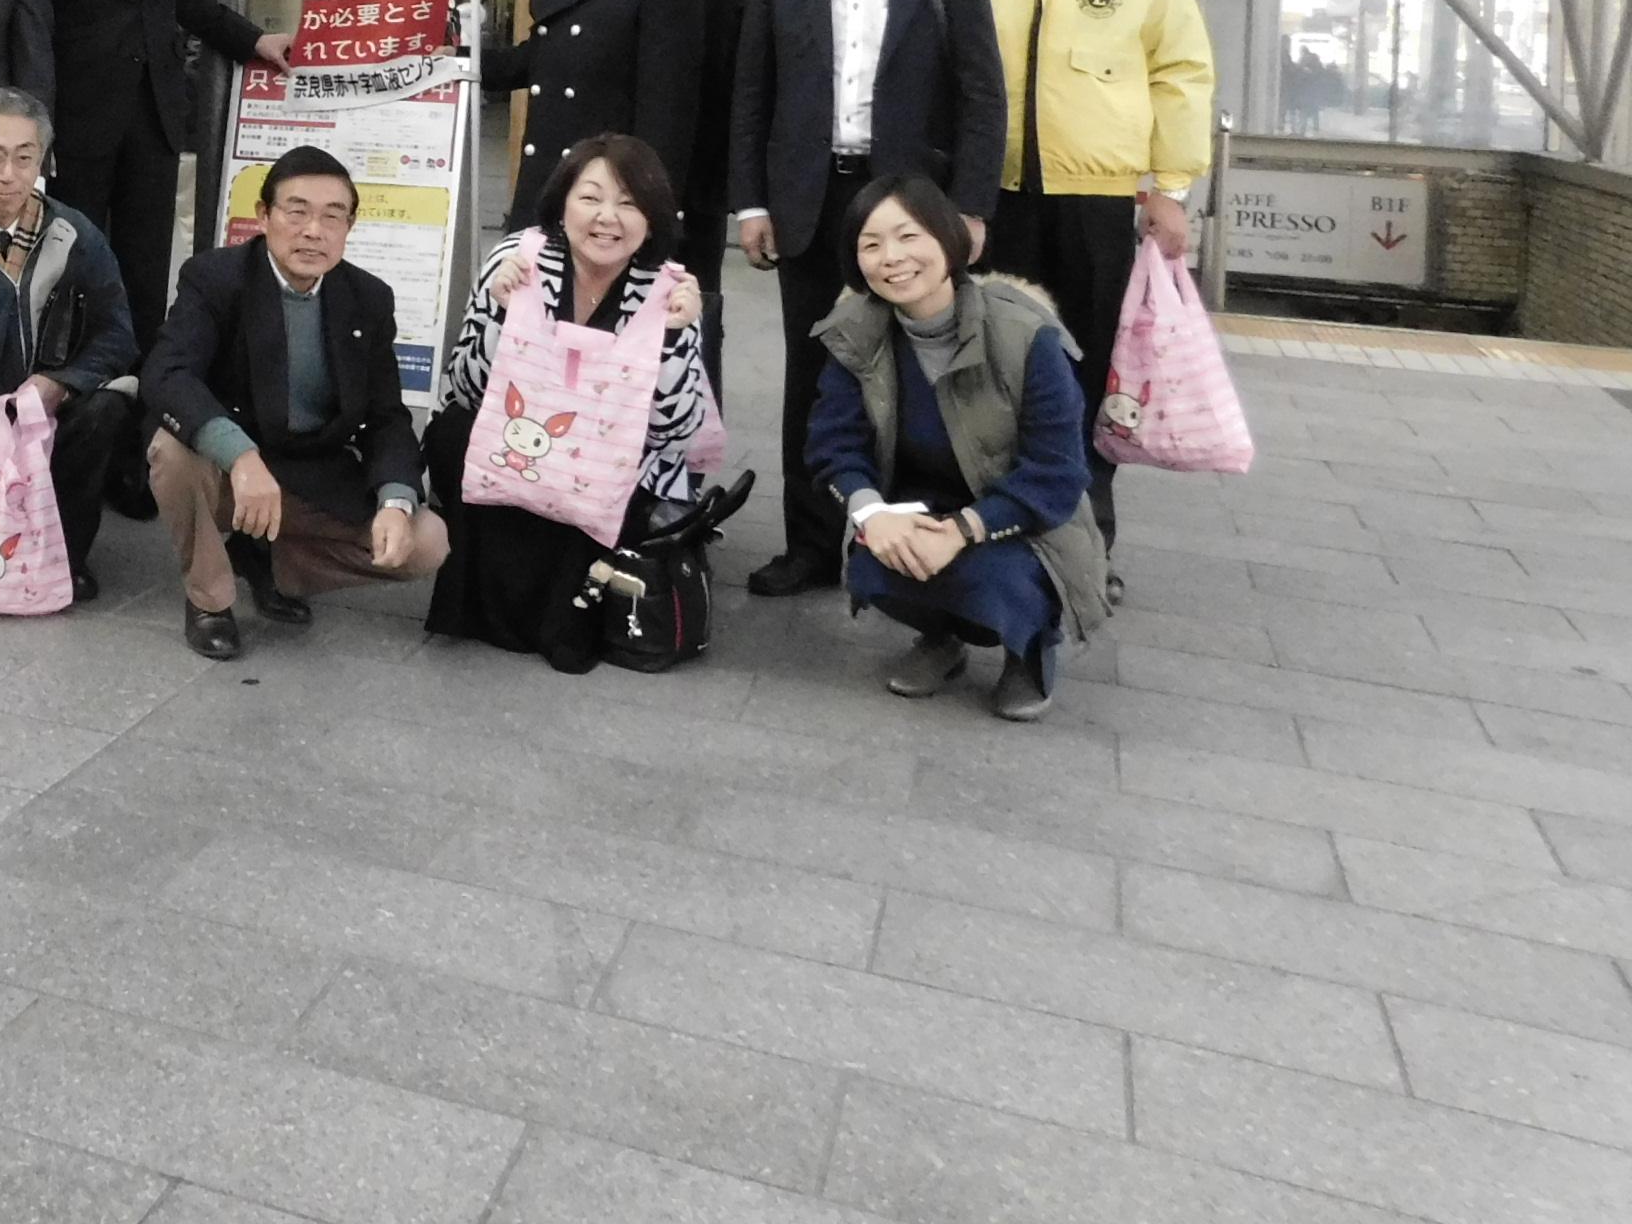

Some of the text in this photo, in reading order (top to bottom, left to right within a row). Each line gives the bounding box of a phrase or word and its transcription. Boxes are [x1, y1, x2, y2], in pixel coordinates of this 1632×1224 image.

[303, 0, 434, 30] が必要とさ
[303, 32, 435, 60] れています。
[293, 55, 445, 98] 奈良県赤十字血液センター
[1235, 210, 1337, 234] PRESSO
